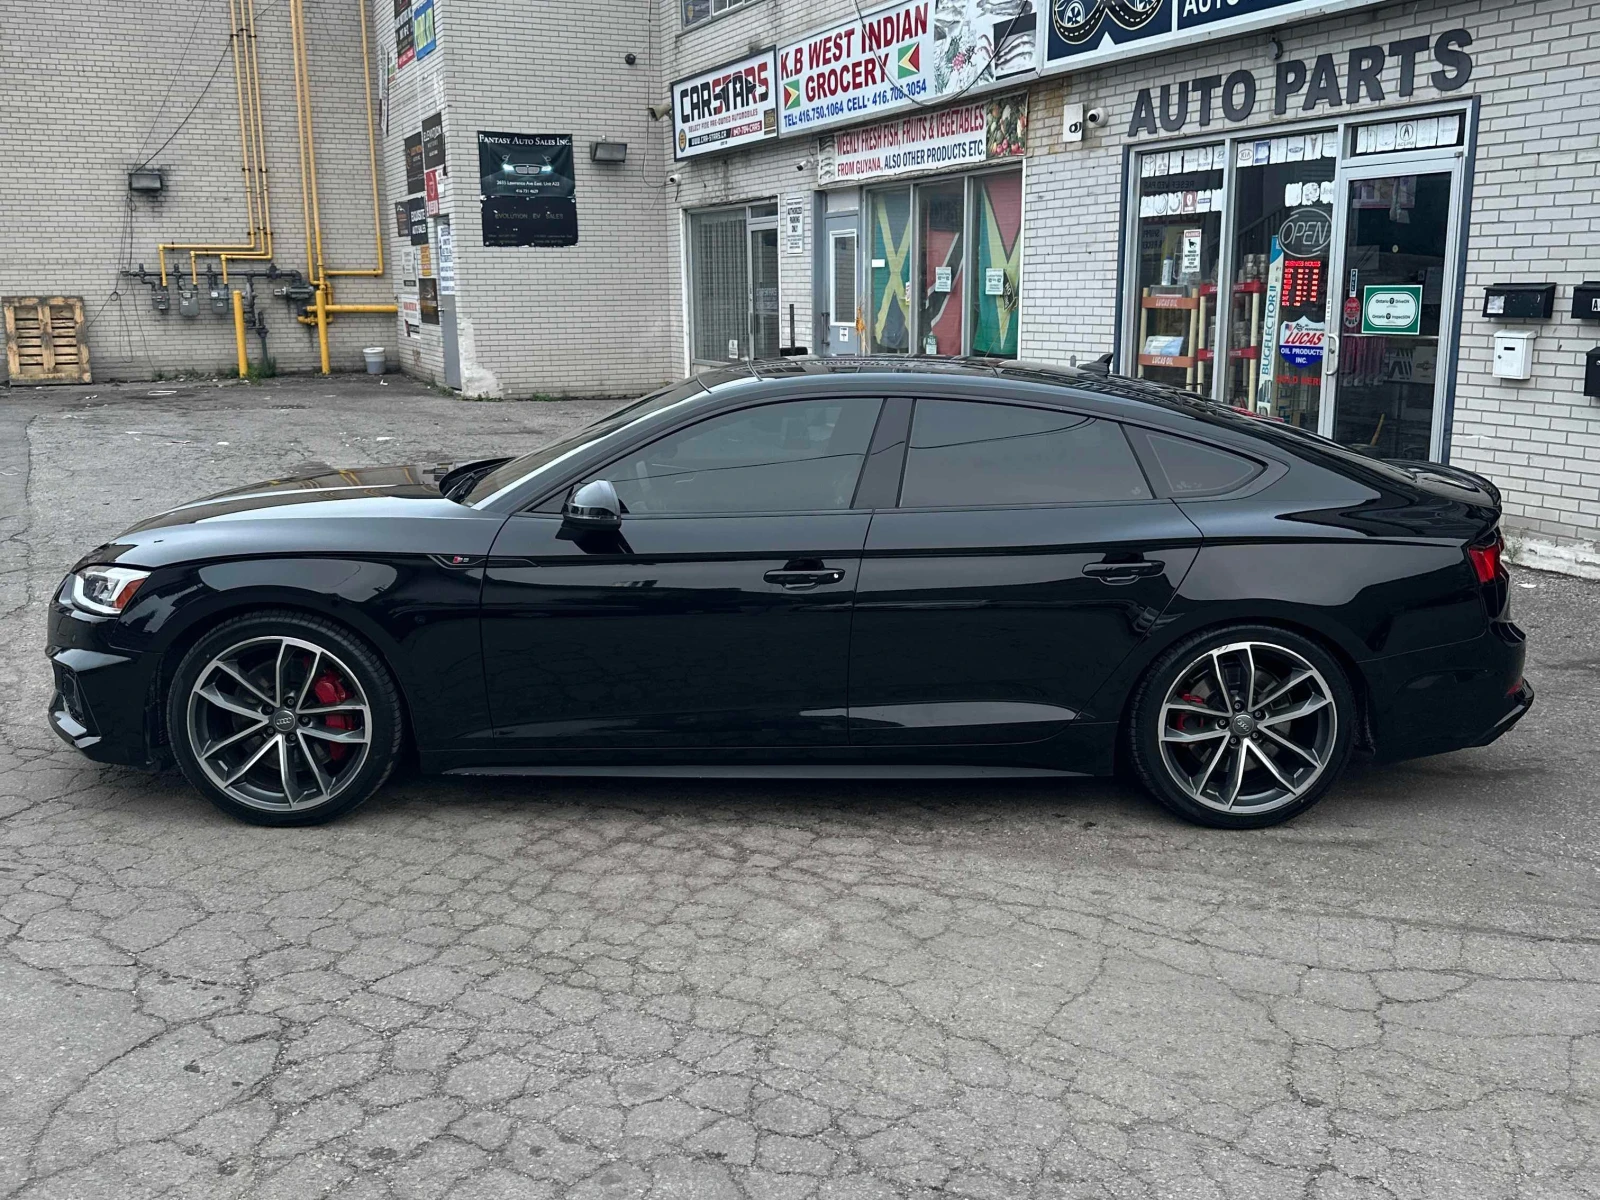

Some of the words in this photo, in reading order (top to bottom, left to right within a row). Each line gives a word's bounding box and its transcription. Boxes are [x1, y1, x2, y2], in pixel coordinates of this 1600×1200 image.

[781, 47, 803, 80] K.B
[809, 28, 855, 70] WEST
[861, 2, 928, 54] INDIAN
[805, 53, 889, 102] GROCERY
[1127, 69, 1257, 137] AUTO
[1275, 28, 1473, 115] PARTS
[784, 115, 798, 127] TEL:
[799, 100, 844, 123] 416.750.1064
[837, 131, 861, 156] WEEKLY
[861, 125, 882, 150] FRESH
[902, 115, 927, 144] FRUITS
[929, 116, 935, 139] &
[935, 104, 984, 138] VEGETABLES
[837, 160, 855, 177] FROM
[856, 156, 883, 174] GUYANA,
[884, 153, 901, 170] ALSO
[902, 150, 925, 166] OTHER
[926, 143, 967, 163] PRODUCTS
[968, 139, 985, 157] ETC.
[1281, 222, 1329, 244] OPEN
[1284, 332, 1324, 345] LUCAS
[1292, 348, 1323, 356] PRODUCTS
